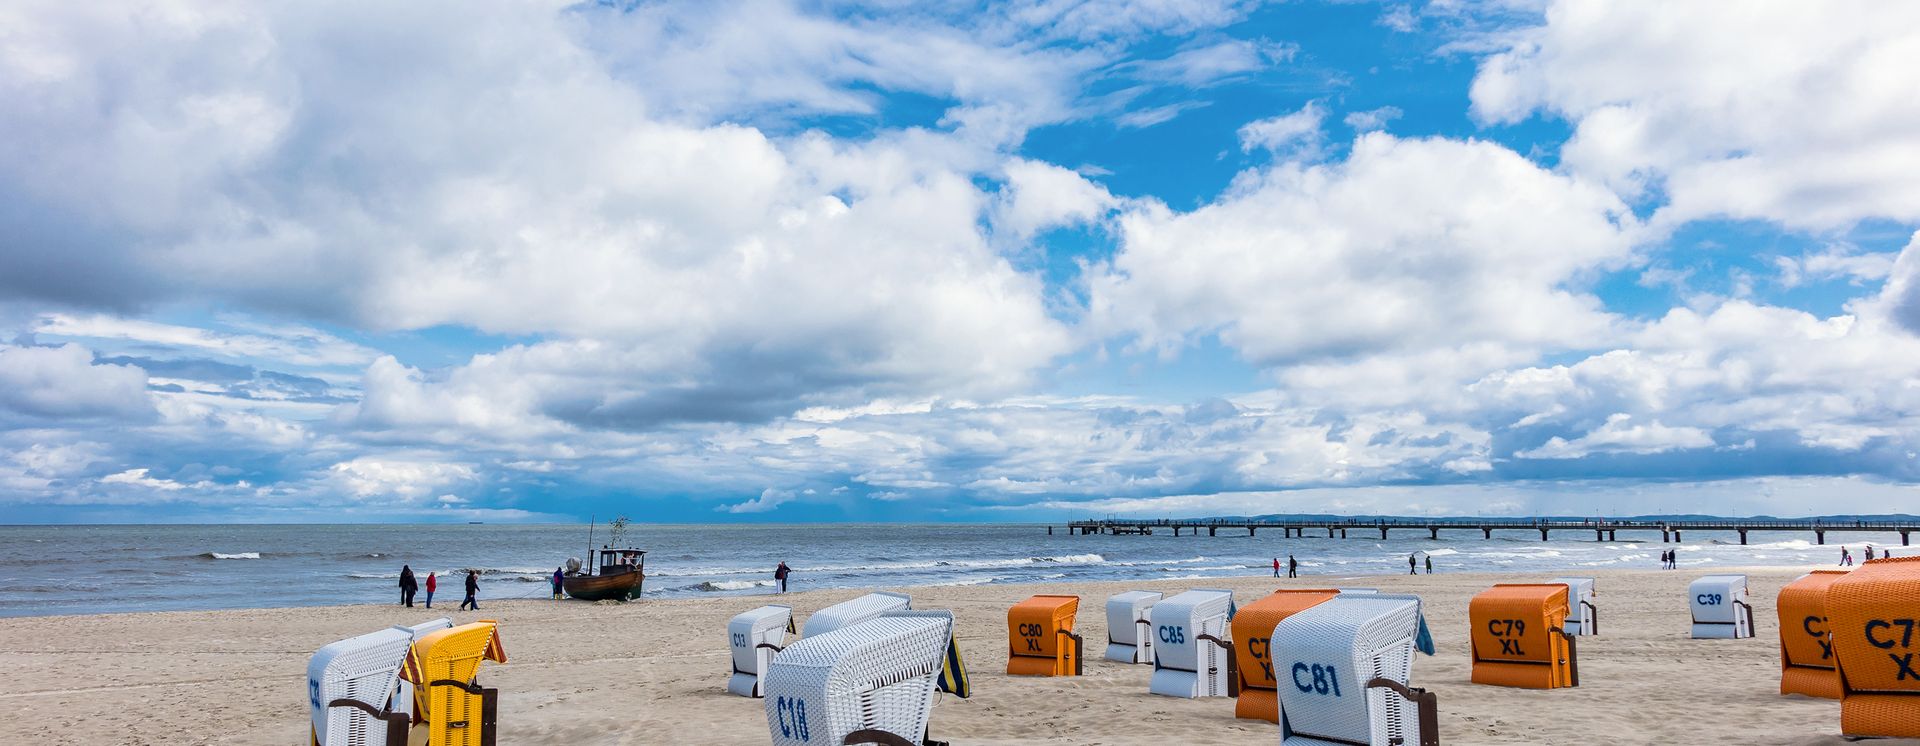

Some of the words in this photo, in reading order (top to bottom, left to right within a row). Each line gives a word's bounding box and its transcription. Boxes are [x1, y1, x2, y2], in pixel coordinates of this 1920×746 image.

[1697, 593, 1722, 605] C39
[1019, 623, 1042, 637] C80
[1159, 625, 1184, 644] C85
[1488, 619, 1525, 637] C79
[1865, 619, 1920, 649] C7
[733, 632, 746, 648] C13
[1026, 638, 1042, 651] XL
[1248, 637, 1271, 659] C7
[1499, 638, 1525, 656] XL
[1889, 653, 1920, 681] X
[1292, 661, 1341, 697] C81
